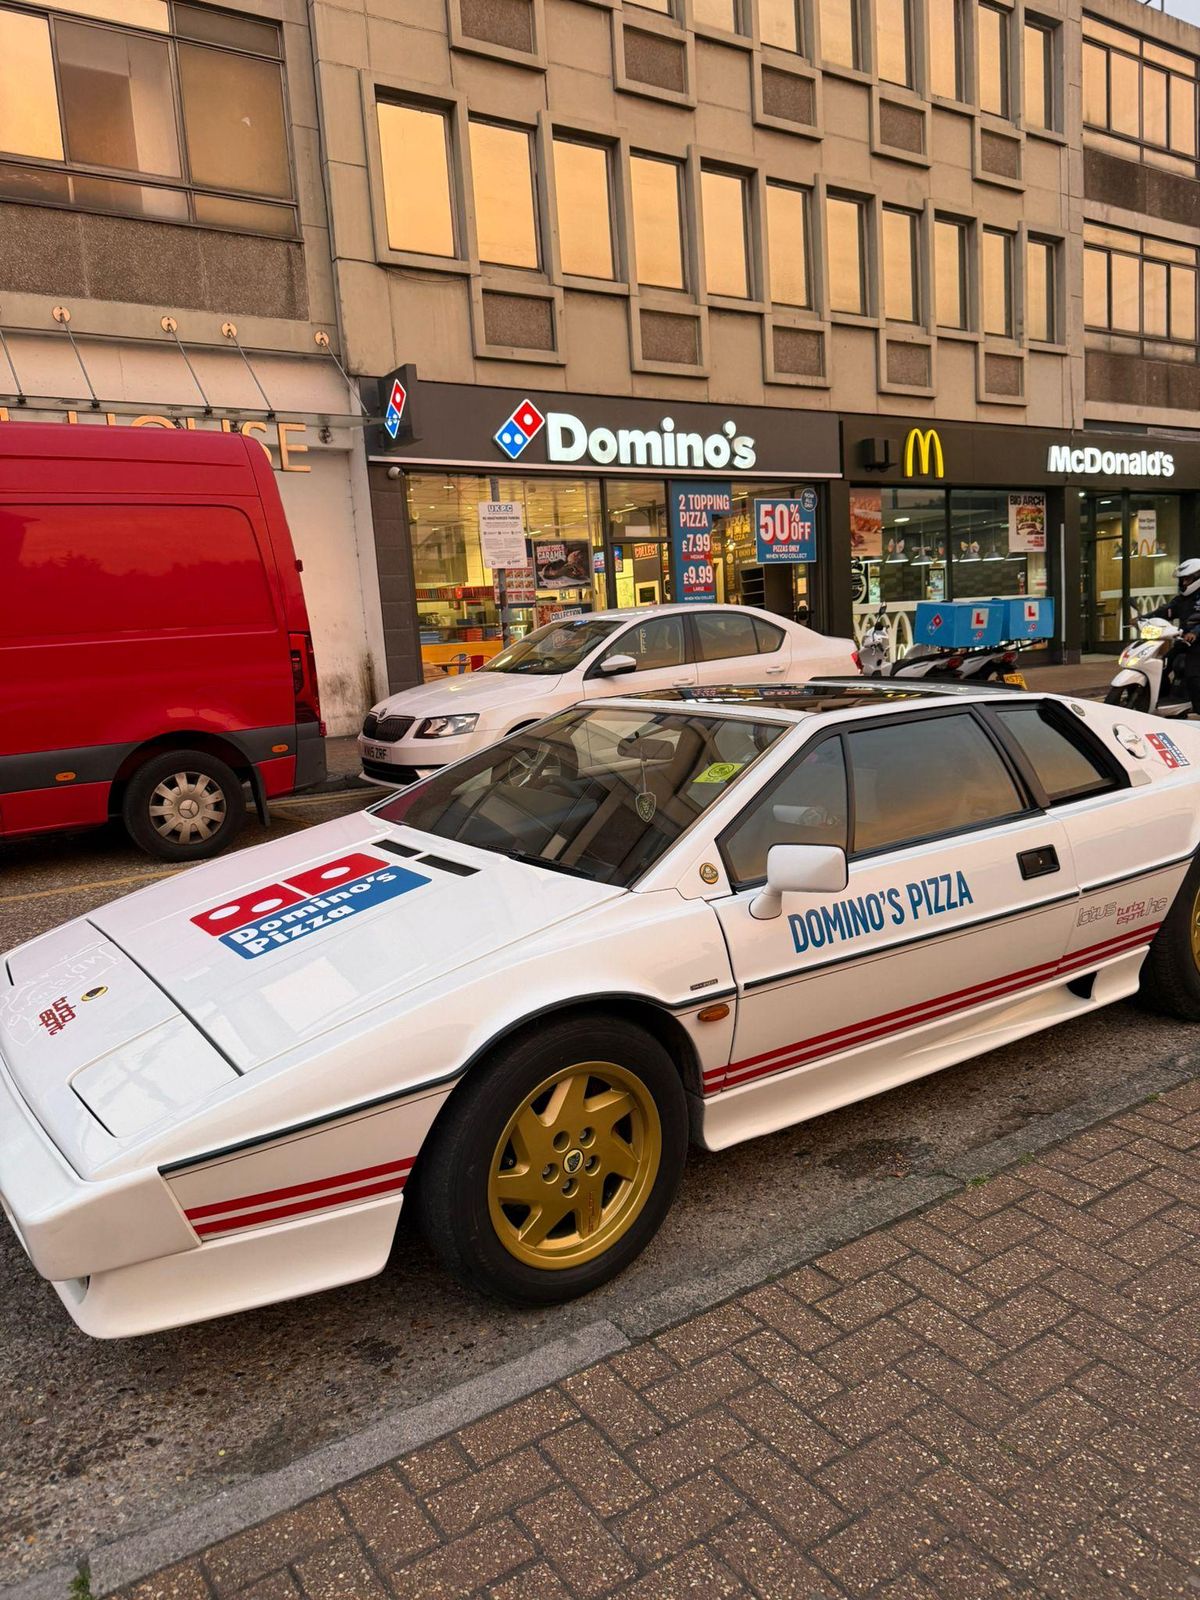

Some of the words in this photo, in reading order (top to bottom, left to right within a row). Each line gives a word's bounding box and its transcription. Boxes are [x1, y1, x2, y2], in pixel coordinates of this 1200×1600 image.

[547, 412, 757, 470] Domino's
[1048, 445, 1175, 478] McDonald's
[679, 494, 686, 510] 2
[688, 494, 730, 511] TOPPING
[1009, 495, 1021, 506] BIG
[1022, 495, 1045, 506] ARCH
[680, 511, 708, 528] PIZZA
[760, 503, 800, 541] 50%
[791, 522, 812, 541] OFF
[682, 533, 711, 552] £7.99
[683, 566, 714, 585] £9.99
[551, 608, 581, 620] COLLECTION
[975, 612, 984, 625] L
[1027, 605, 1036, 617] L
[228, 871, 398, 945] Domino's
[787, 887, 905, 954] DOMINO'S
[906, 870, 974, 920] PIZZA
[1116, 901, 1145, 917] turbo
[242, 904, 356, 955] Pizza
